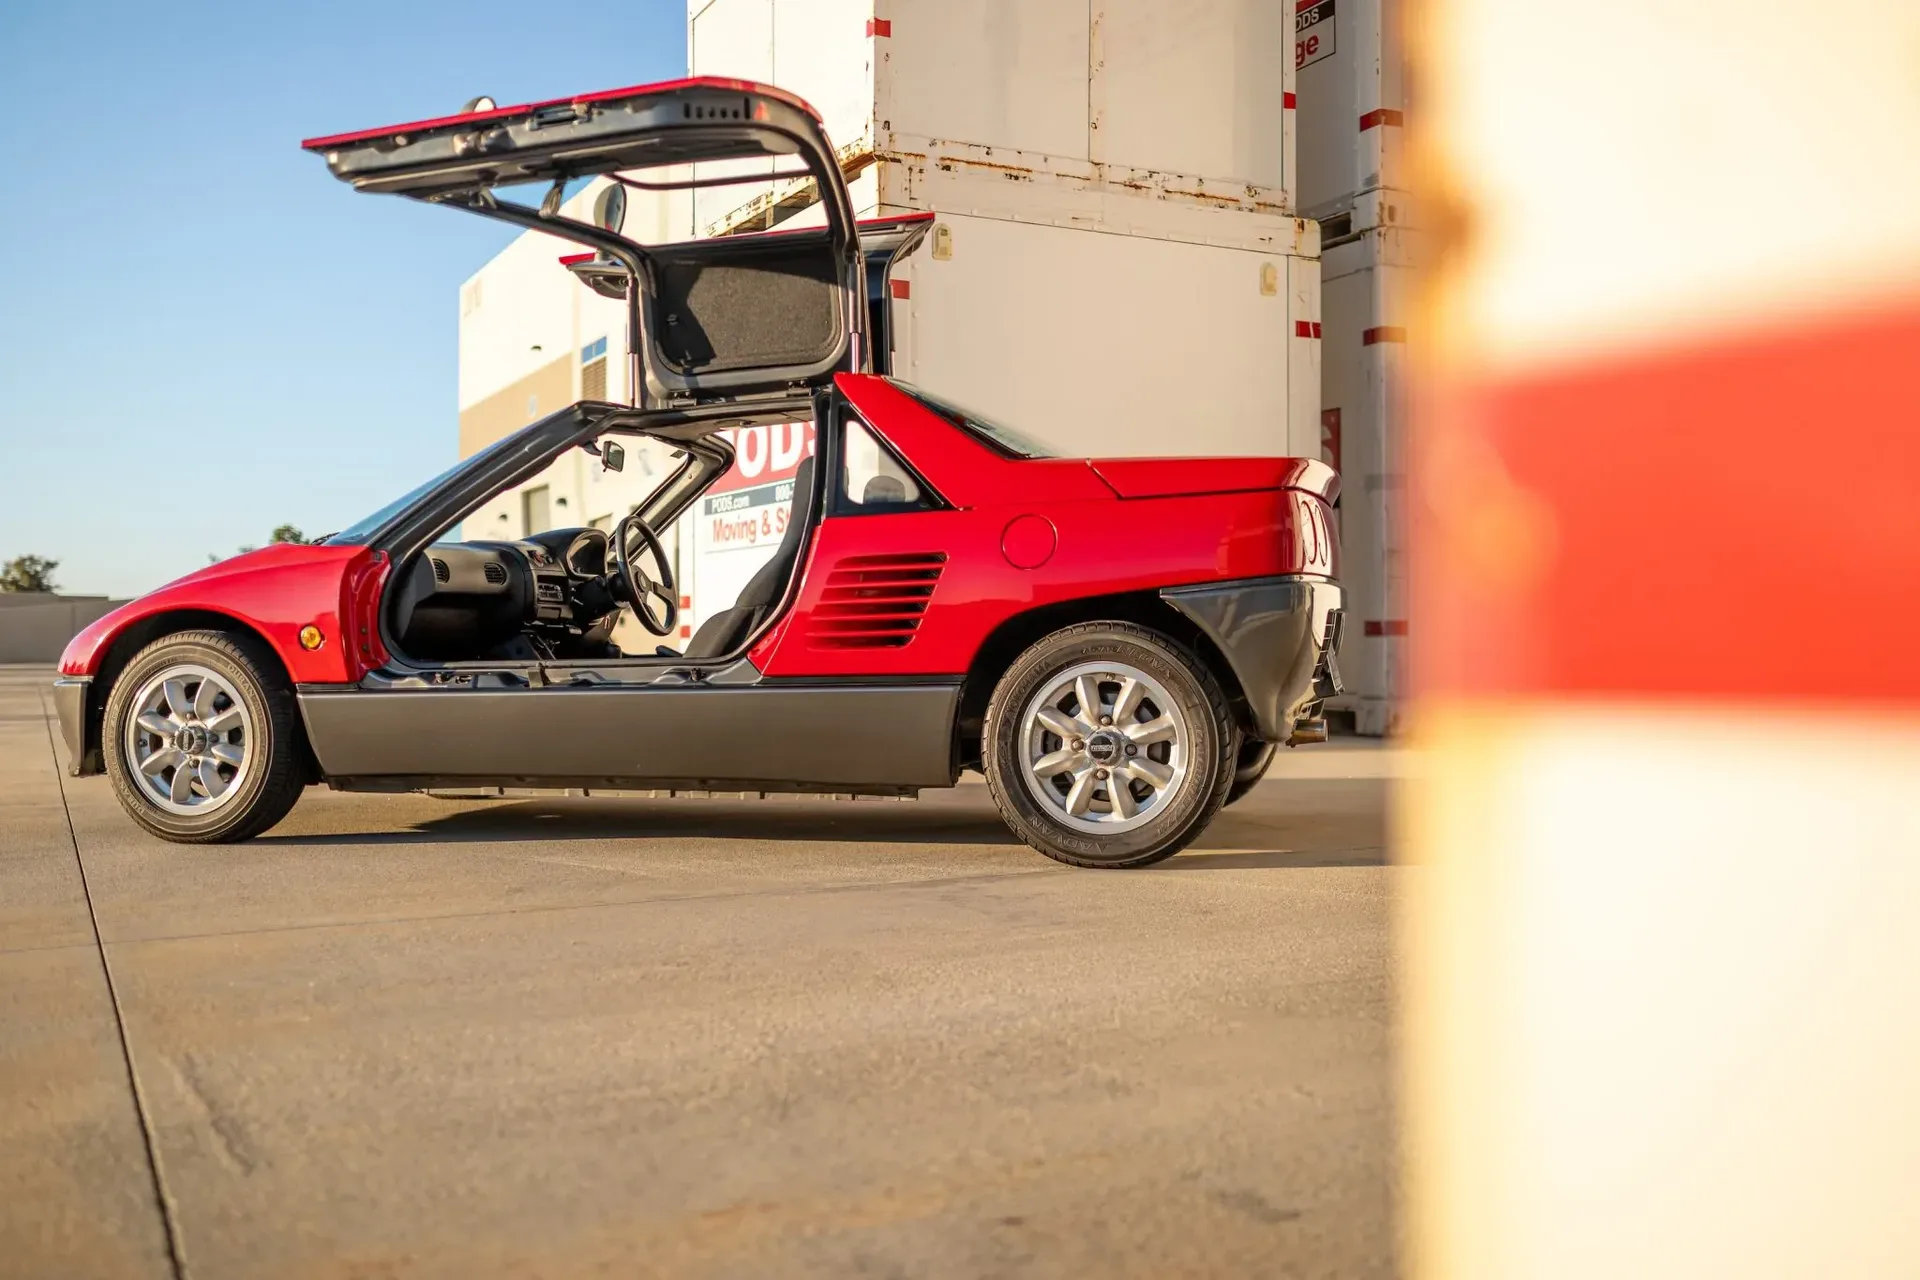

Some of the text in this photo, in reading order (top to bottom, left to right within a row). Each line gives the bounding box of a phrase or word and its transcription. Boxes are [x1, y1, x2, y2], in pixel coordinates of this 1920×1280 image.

[711, 495, 750, 513] PODS.com
[713, 518, 757, 543] Moving
[762, 510, 771, 536] &
[227, 663, 255, 698] DURAN
